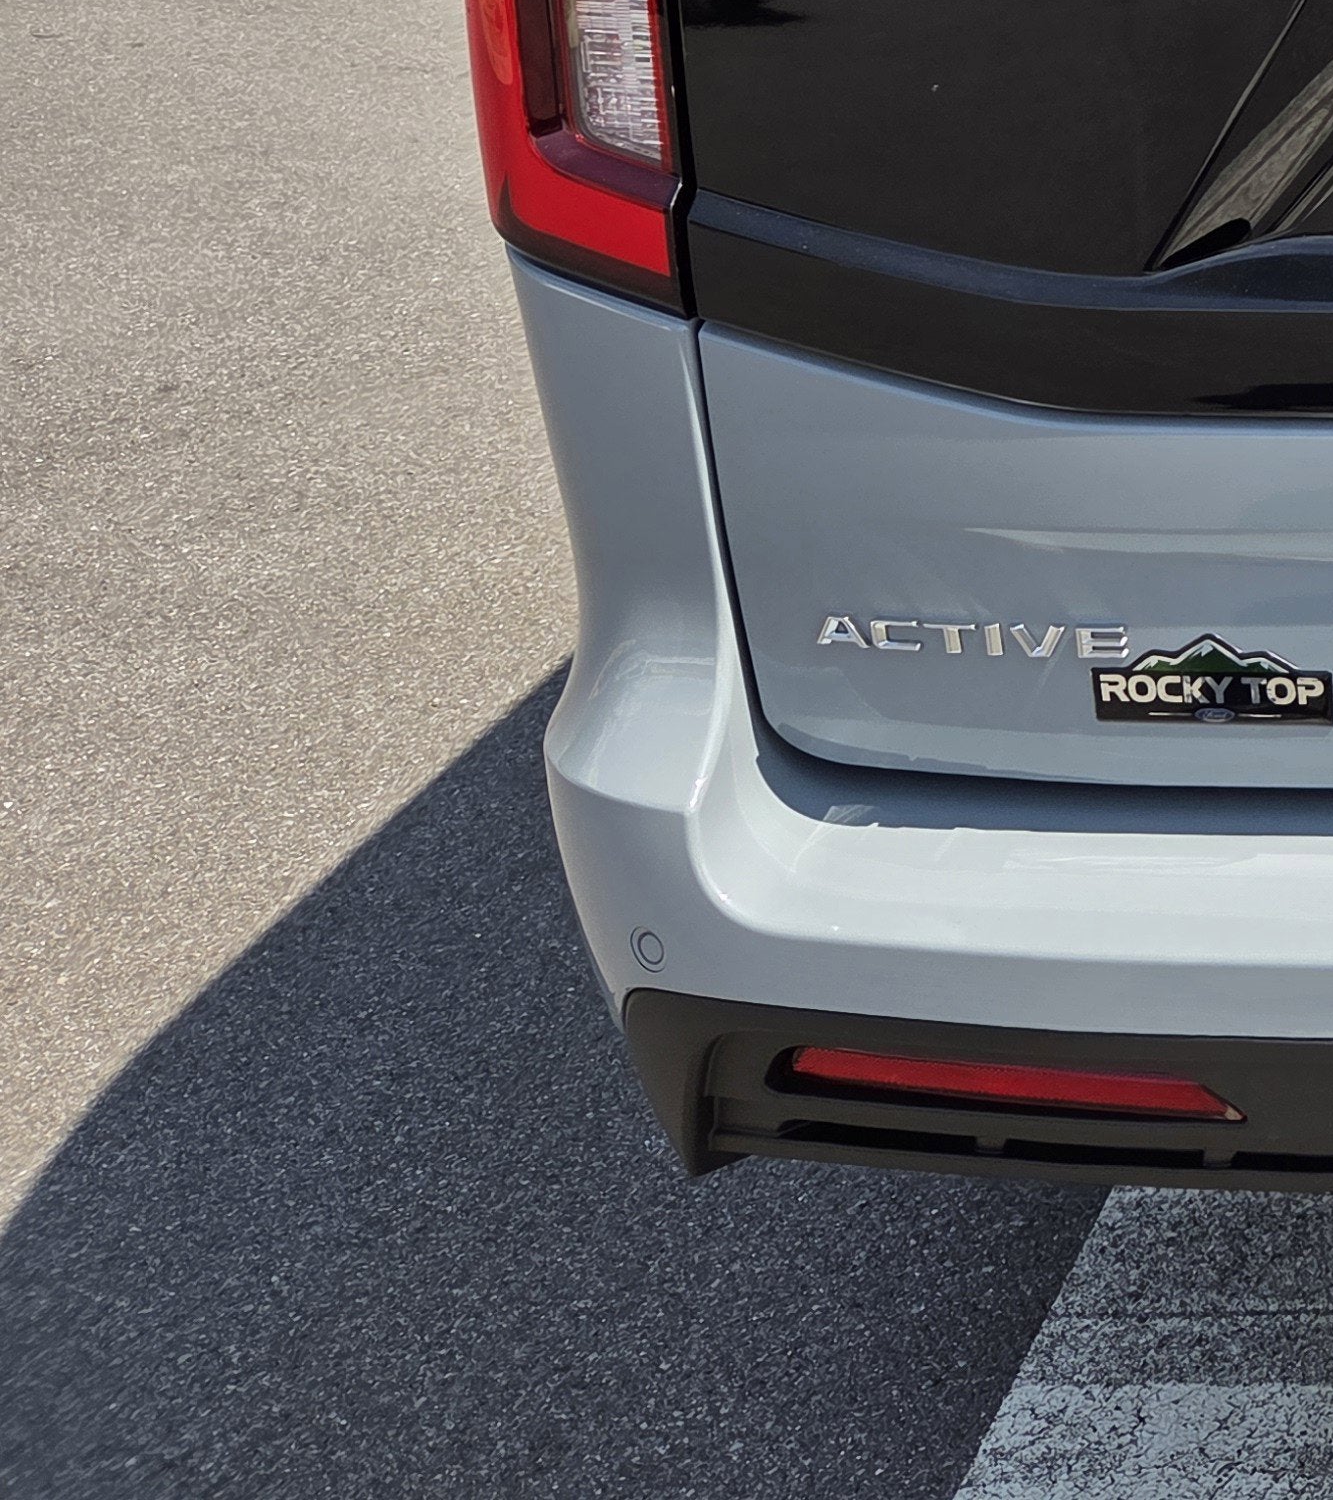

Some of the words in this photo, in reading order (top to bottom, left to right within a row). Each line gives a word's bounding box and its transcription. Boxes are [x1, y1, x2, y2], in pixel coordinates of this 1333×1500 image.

[817, 615, 1131, 659] ACTIVE
[1100, 673, 1234, 705] ROCKY
[1241, 676, 1325, 706] TOP
